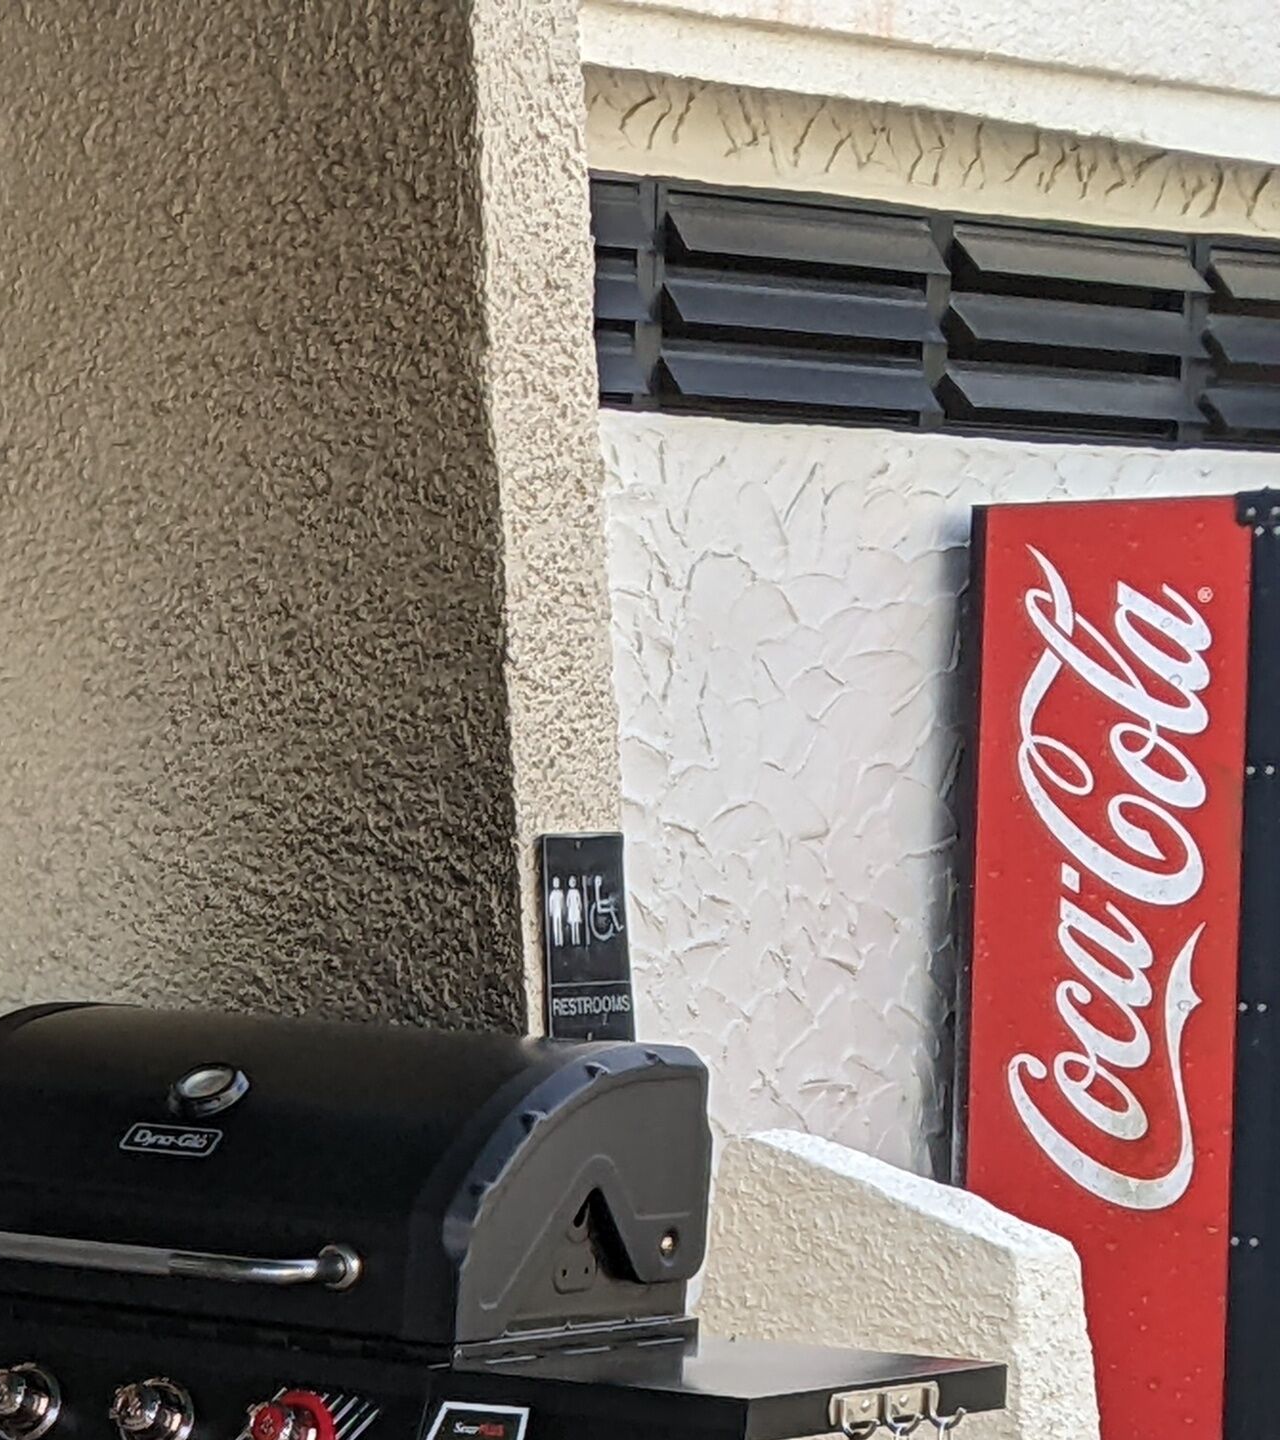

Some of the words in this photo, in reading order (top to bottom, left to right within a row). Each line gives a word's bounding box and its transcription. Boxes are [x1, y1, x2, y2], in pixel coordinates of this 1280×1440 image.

[1008, 543, 1213, 1210] Coca-Cola
[552, 994, 631, 1016] RESTROOMS
[134, 1129, 208, 1148] Dyna-Glo
